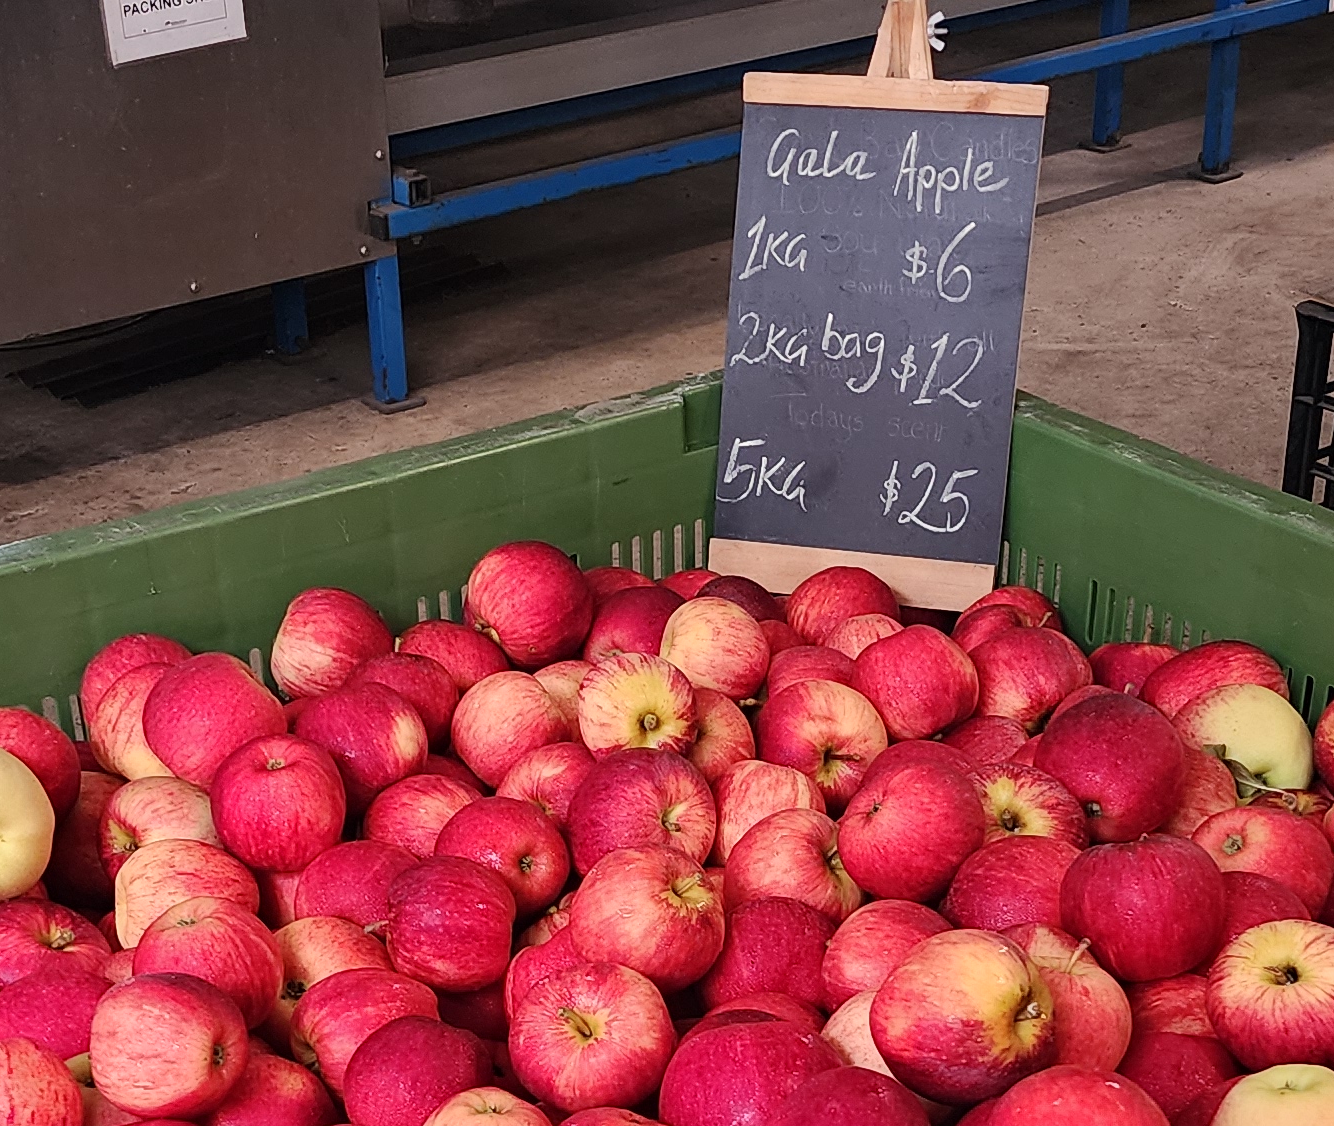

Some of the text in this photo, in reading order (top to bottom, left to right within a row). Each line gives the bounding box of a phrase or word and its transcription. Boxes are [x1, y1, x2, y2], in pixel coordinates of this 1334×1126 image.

[123, 0, 181, 17] PACKING
[766, 128, 876, 185] Gala
[894, 130, 1009, 213] Apple
[902, 222, 976, 302] $6
[822, 312, 885, 393] bag
[891, 333, 984, 408] $12
[880, 460, 978, 533] $25
